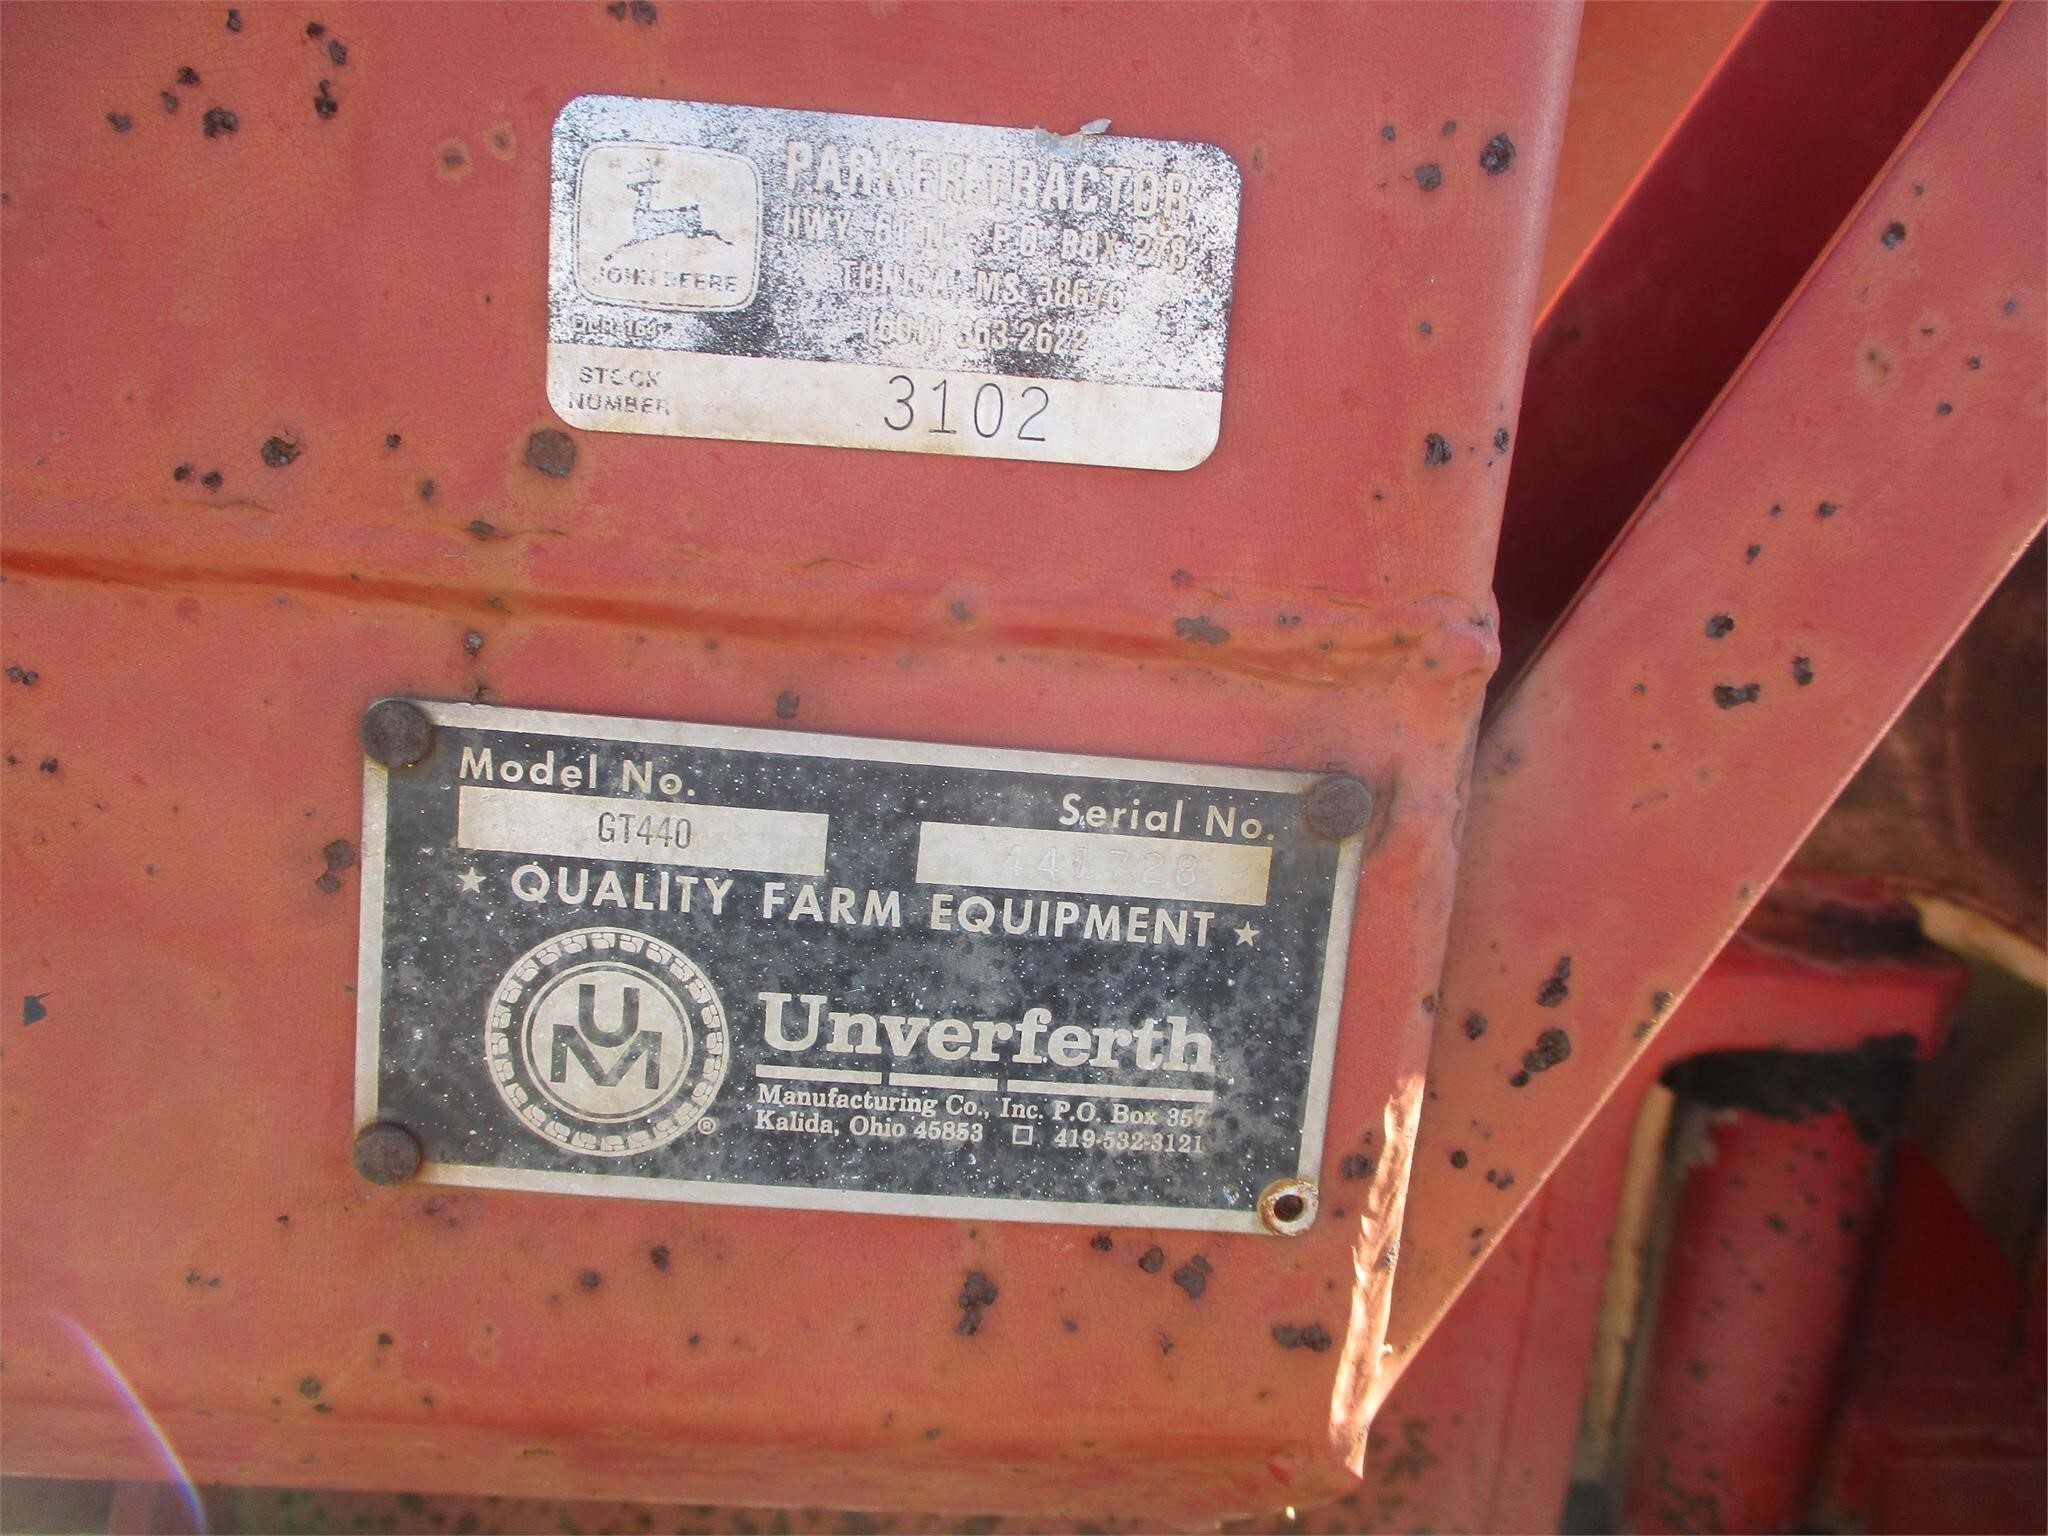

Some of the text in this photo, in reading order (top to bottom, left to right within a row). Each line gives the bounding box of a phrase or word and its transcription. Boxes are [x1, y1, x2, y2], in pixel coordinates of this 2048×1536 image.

[784, 140, 1192, 217] PARKER TRACTOR
[1062, 228, 1120, 263] BOX
[663, 271, 738, 293] DEERE
[975, 270, 1020, 304] MS
[1035, 275, 1128, 314] 38676
[579, 366, 661, 388] STOCK
[568, 391, 670, 416] NUMBER
[884, 374, 1050, 442] 3102
[459, 746, 696, 797] Model No.
[597, 812, 692, 849] GT440
[1058, 793, 1275, 841] Serial No.
[1001, 844, 1198, 888] 441728
[511, 864, 1216, 948] QUALITY FARM EQUIPMENT
[758, 991, 1216, 1073] Unverferth
[757, 1084, 1207, 1129] Manufacturing Co., Inc. P.O. Box 357
[755, 1110, 1203, 1155] Kalida, Ohio 45853 419-532-3121
